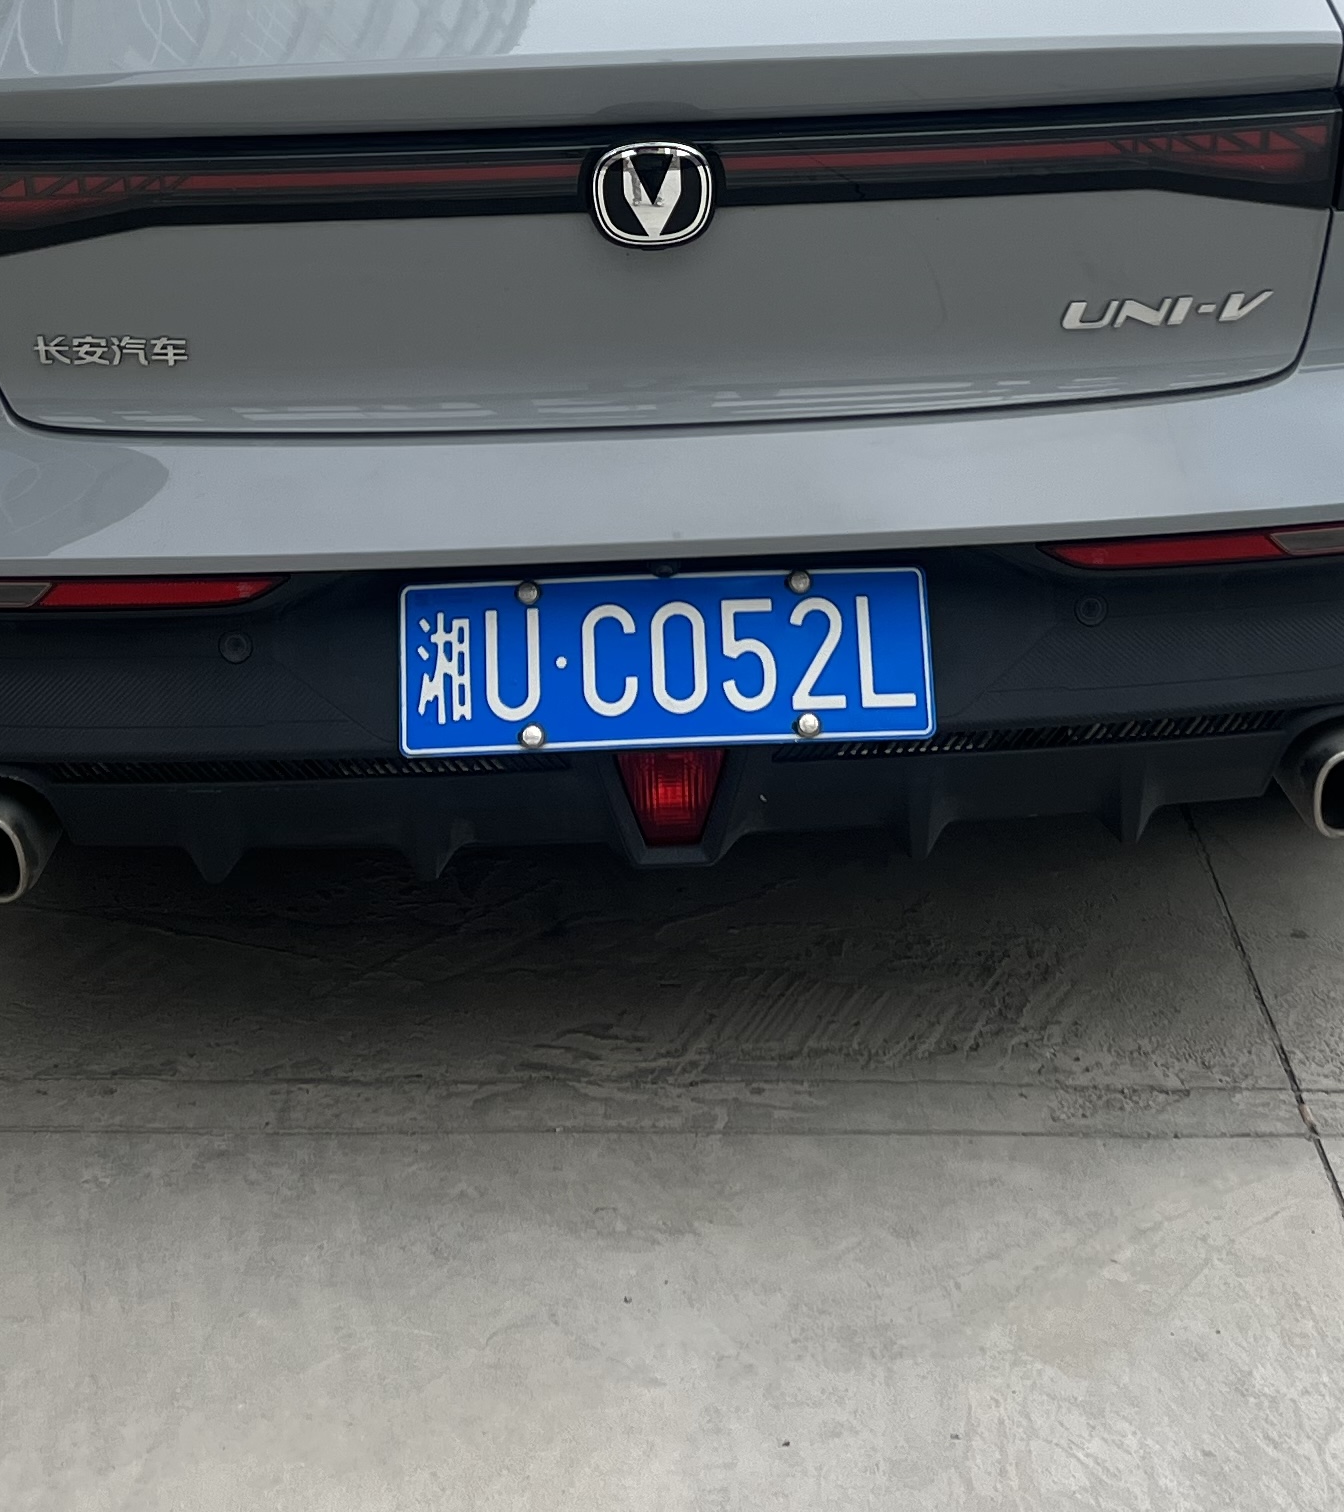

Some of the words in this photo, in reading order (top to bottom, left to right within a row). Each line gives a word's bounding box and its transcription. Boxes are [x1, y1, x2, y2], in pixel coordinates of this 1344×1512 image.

[1061, 289, 1274, 330] UNI-V
[33, 335, 188, 366] 长安汽车
[418, 595, 917, 724] 湘U·C052L
